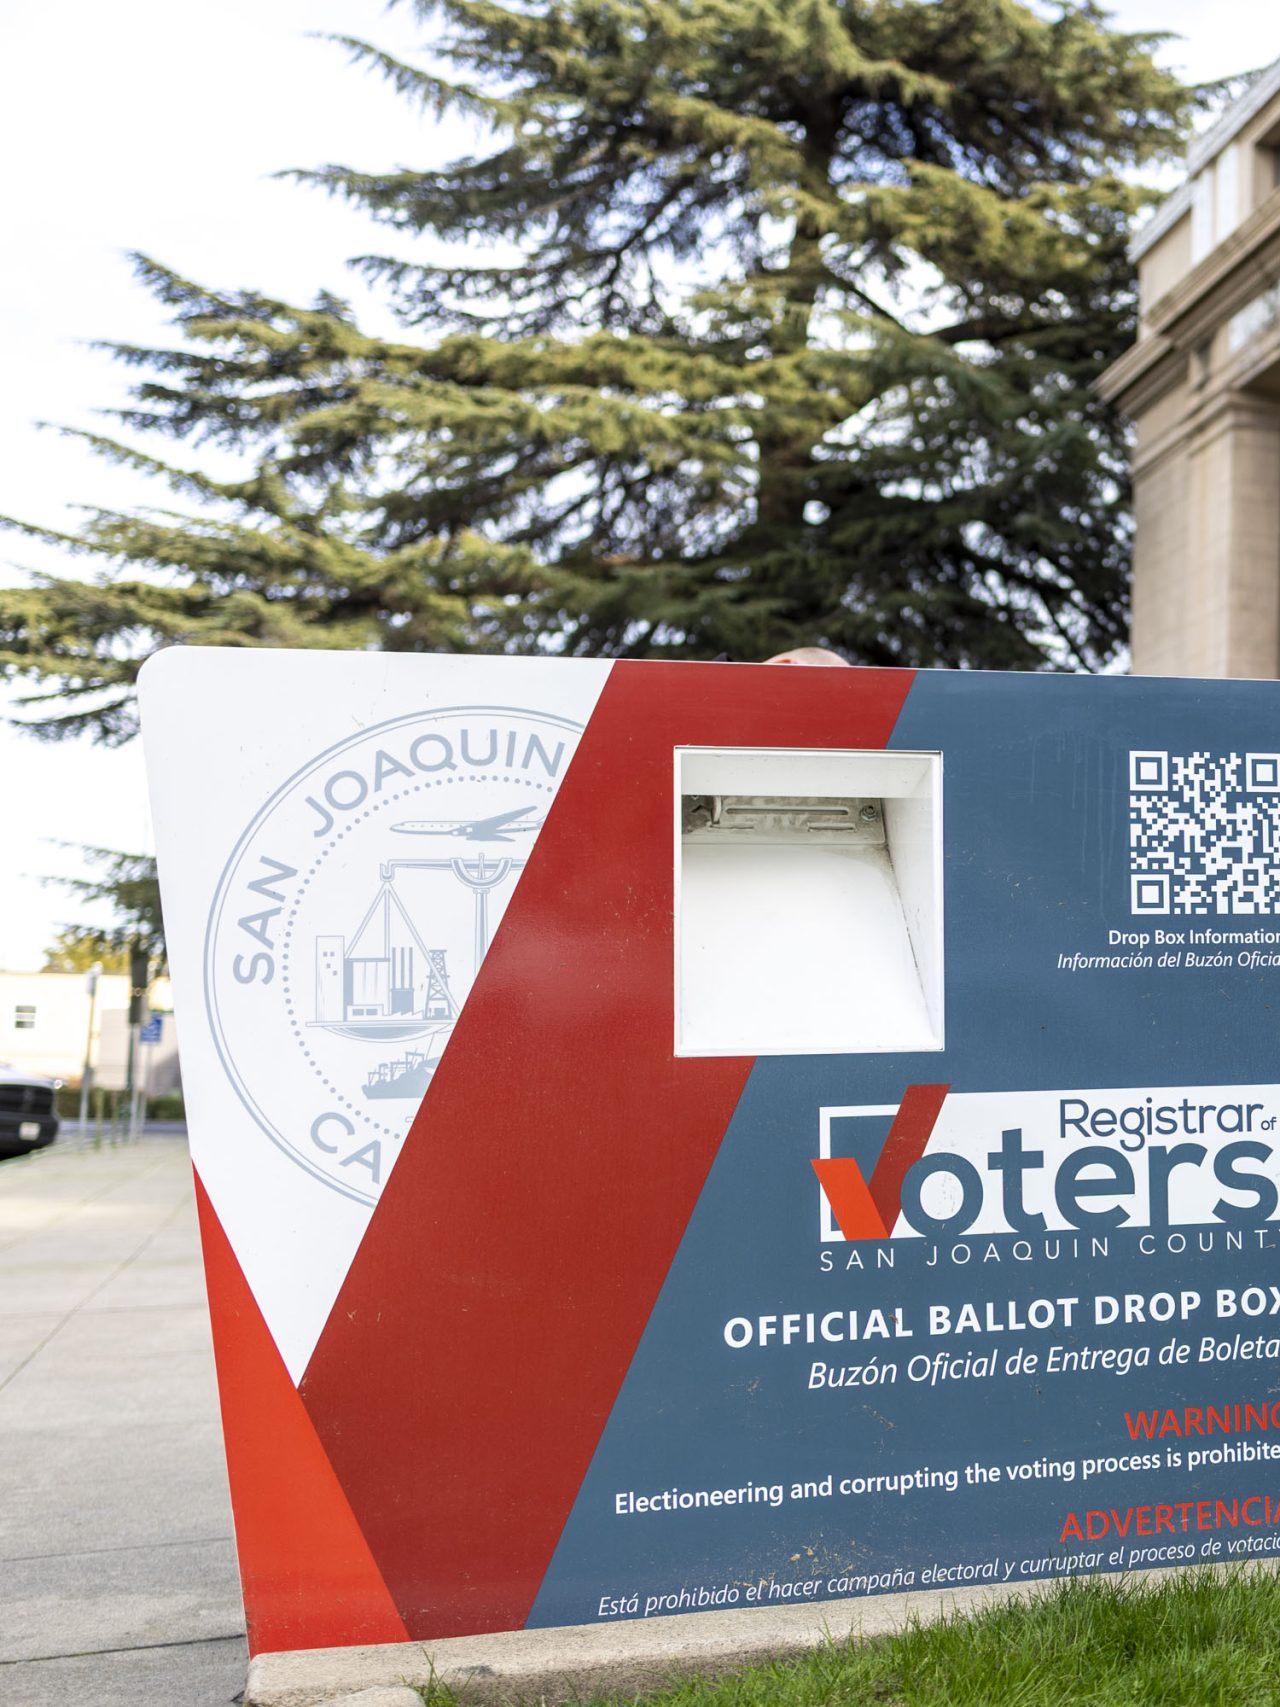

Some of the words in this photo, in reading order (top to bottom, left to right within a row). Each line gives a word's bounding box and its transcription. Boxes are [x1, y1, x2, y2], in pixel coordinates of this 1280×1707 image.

[233, 855, 298, 986] SAN
[304, 728, 566, 838] JOAQUIN
[1057, 953, 1153, 971] Información
[1157, 952, 1181, 967] del
[1185, 951, 1233, 968] Buzón
[1108, 930, 1150, 948] Drop
[1155, 930, 1186, 945] Box
[1059, 1097, 1264, 1151] Registrar
[1260, 1116, 1278, 1131] of
[819, 1248, 895, 1272] SAN
[926, 1237, 1109, 1266] JOAQUIN
[723, 1307, 913, 1348] OFFICIAL
[929, 1297, 1079, 1334] BALLOT
[1095, 1291, 1201, 1325] DROP
[808, 1356, 897, 1389] Buzón
[907, 1349, 997, 1386] Oficial
[1005, 1347, 1037, 1375] de
[1047, 1341, 1151, 1377] Entrega
[1158, 1338, 1190, 1365] de
[615, 1481, 784, 1514] Electioneering
[790, 1475, 833, 1500] and
[839, 1467, 958, 1496] corrupting
[964, 1463, 1001, 1484] the
[1006, 1457, 1076, 1482] voting
[1082, 1452, 1161, 1479] process
[1166, 1447, 1182, 1467] is
[598, 1592, 639, 1616] Está
[645, 1583, 740, 1616] prohibido
[746, 1580, 765, 1600] el
[768, 1576, 822, 1599] hacer
[827, 1567, 915, 1596] campaña
[921, 1556, 1000, 1584] electoral
[1002, 1562, 1015, 1580] y
[1020, 1550, 1104, 1575] curruptar
[1109, 1547, 1124, 1565] el
[1128, 1543, 1196, 1567] proceso
[1201, 1538, 1221, 1556] de
